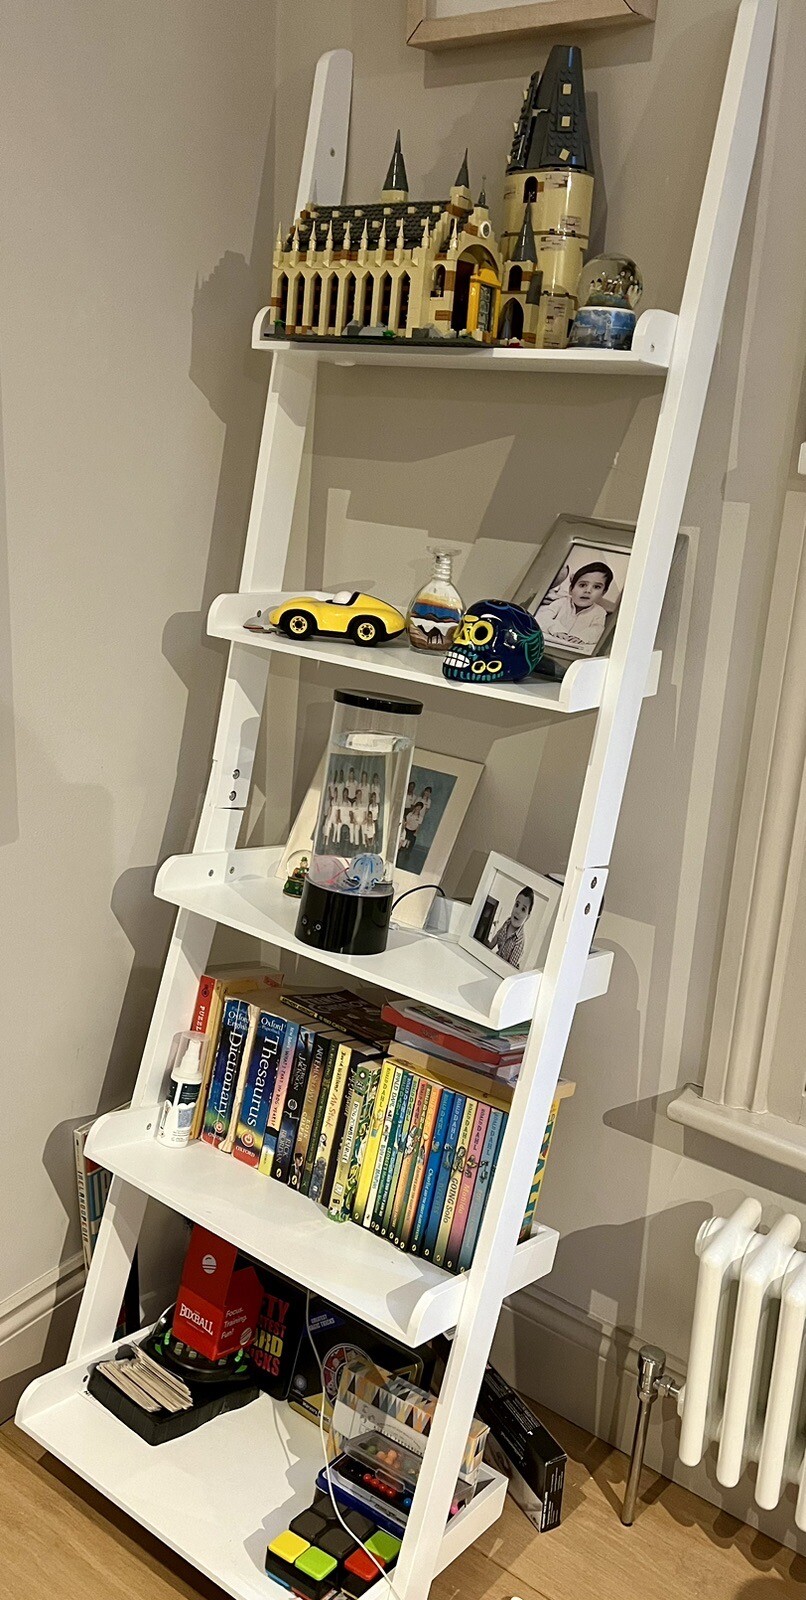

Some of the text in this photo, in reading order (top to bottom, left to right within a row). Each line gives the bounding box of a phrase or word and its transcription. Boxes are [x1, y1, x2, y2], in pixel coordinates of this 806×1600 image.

[195, 1005, 206, 1031] PUZZL
[260, 1017, 284, 1032] Oxford
[211, 1031, 244, 1118] Dictionary
[311, 1044, 323, 1078] ARTEMIS
[245, 1033, 279, 1127] Thesaurus
[275, 1129, 287, 1163] RIORDAN
[425, 1168, 433, 1188] Charlie
[443, 1177, 459, 1223] GOING Solo
[457, 1183, 470, 1215] Matilda
[180, 1303, 213, 1336] BOXBALL
[224, 1316, 248, 1328] Training.
[226, 1308, 244, 1318] Focus.
